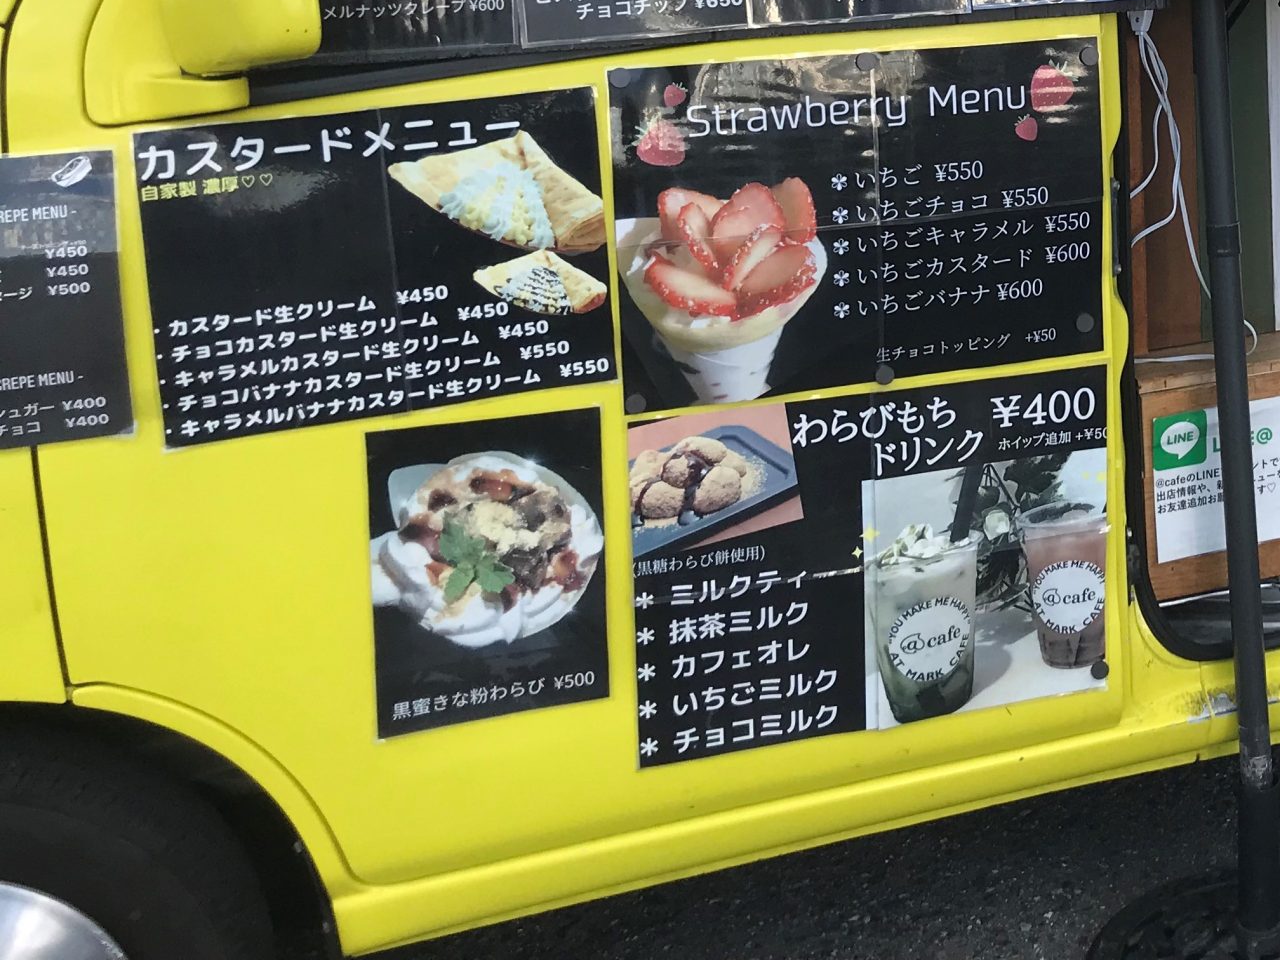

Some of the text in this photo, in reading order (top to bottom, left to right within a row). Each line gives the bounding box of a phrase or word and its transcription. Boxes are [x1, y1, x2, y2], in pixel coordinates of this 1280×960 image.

[686, 82, 1027, 138] Strawberry Menu
[138, 118, 522, 182] カスタードメニュー
[140, 179, 199, 202] 自家製
[855, 159, 985, 190] いちご ¥550
[32, 204, 68, 220] MENU
[856, 185, 1049, 223] いちごチョコ ¥550
[857, 210, 1092, 255] いちごキャラメル ¥550
[44, 245, 88, 260] ¥450
[46, 263, 89, 278] ¥450
[857, 240, 1092, 288] いちごカスタード ¥600
[47, 281, 91, 296] ¥500
[857, 277, 1044, 316] いちごバナナ ¥600
[167, 284, 449, 337] カスタード生クリーム ¥450
[171, 300, 510, 364] チョコカスタード生クリーム ¥450
[876, 327, 1057, 365] 生チョコトッピング +¥50
[174, 319, 550, 388] キャラメルカスタード生クリーム ¥450
[38, 370, 75, 387] MENU
[177, 339, 571, 414] チョコバナナカスタード生クリーム ¥550
[61, 396, 107, 411] ¥400
[181, 356, 610, 439] キャラメルバナナカスタード生クリーム ¥550
[65, 413, 110, 428] ¥400
[792, 386, 1096, 449] わらびもち ¥400
[873, 429, 985, 476] ドリンク
[998, 430, 1072, 452] ホイップ追加
[1166, 430, 1194, 446] LINE
[1070, 560, 1086, 569] ME
[668, 601, 809, 646] 抹茶ミルク
[901, 600, 933, 621] MAKE
[934, 596, 950, 607] ME
[1045, 618, 1079, 634] MARK
[671, 638, 811, 680] カフェオレ
[890, 652, 905, 668] AT
[905, 667, 945, 682] MARK
[392, 670, 596, 721] 黒蜜きな粉わらび ¥500
[672, 669, 838, 717] いちごミルク
[673, 704, 839, 754] チョコミルク
